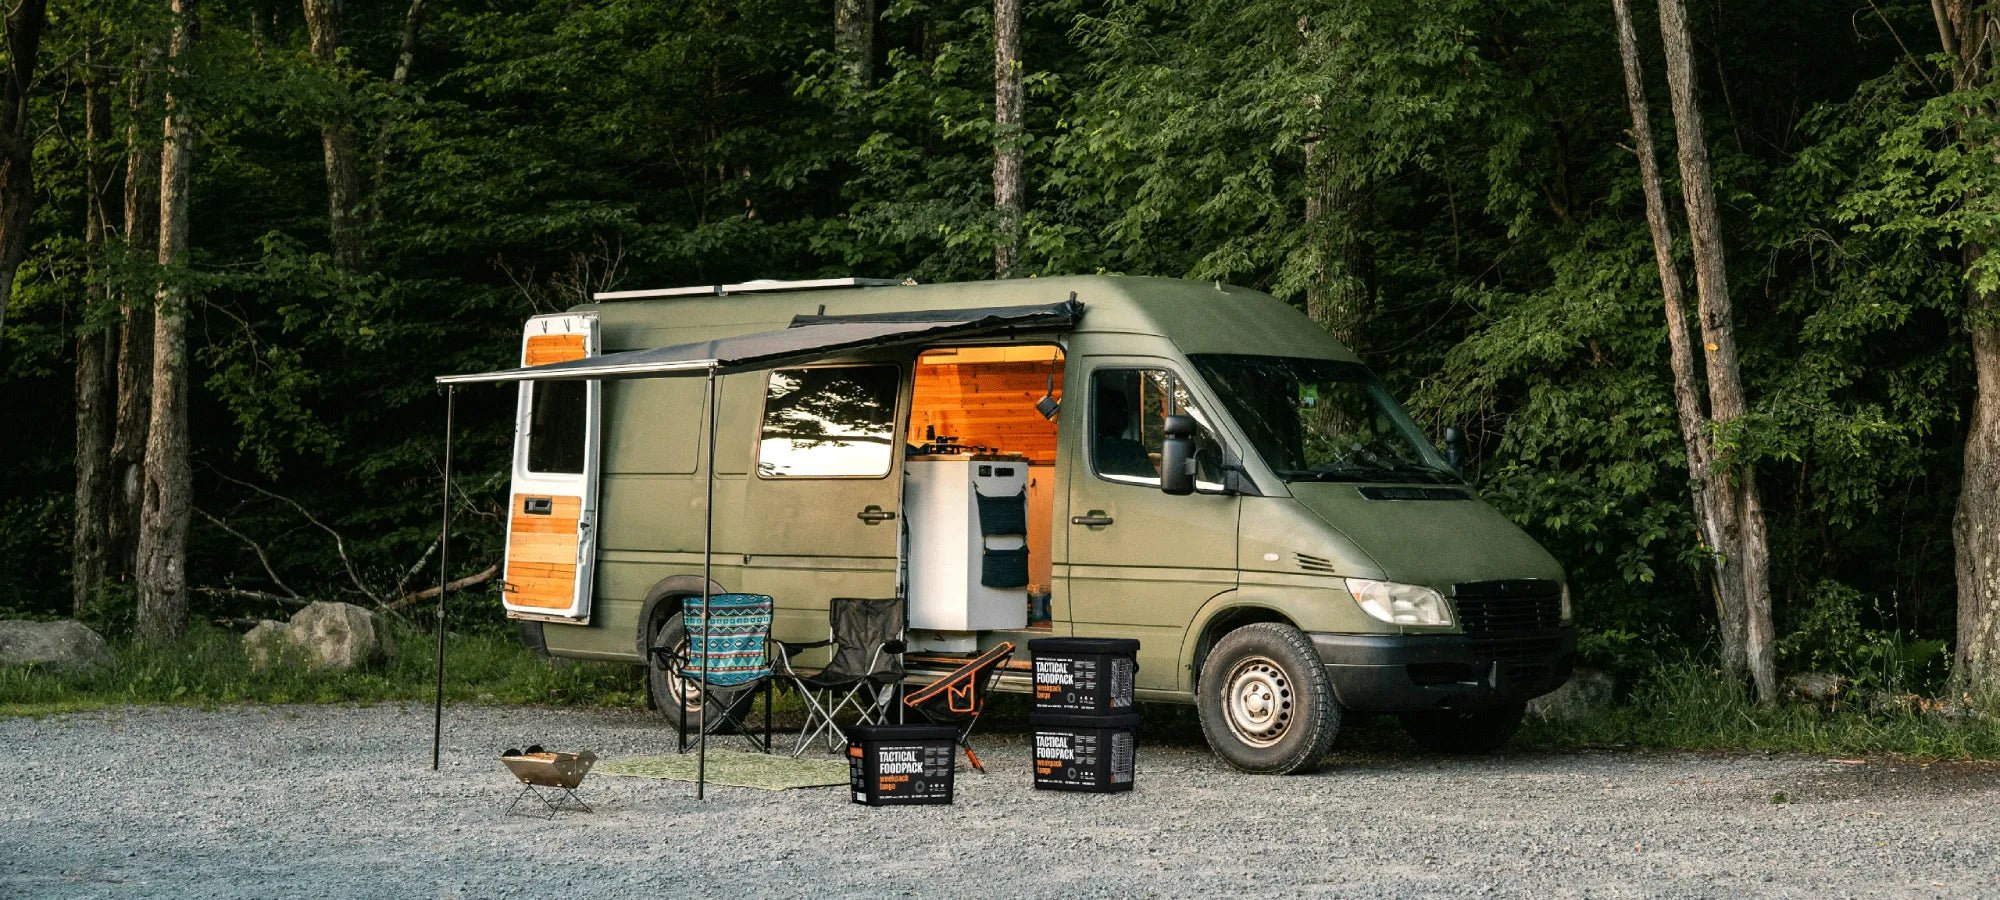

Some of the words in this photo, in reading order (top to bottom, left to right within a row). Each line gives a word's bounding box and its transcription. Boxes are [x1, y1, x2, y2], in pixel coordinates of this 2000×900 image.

[1036, 662, 1068, 674] TACTICAL
[1037, 673, 1074, 685] FOODPACK
[1036, 736, 1068, 748] TACTICAL
[879, 751, 917, 763] TACTICAL
[1037, 748, 1074, 760] FOODPACK
[880, 762, 924, 774] FOODPACK
